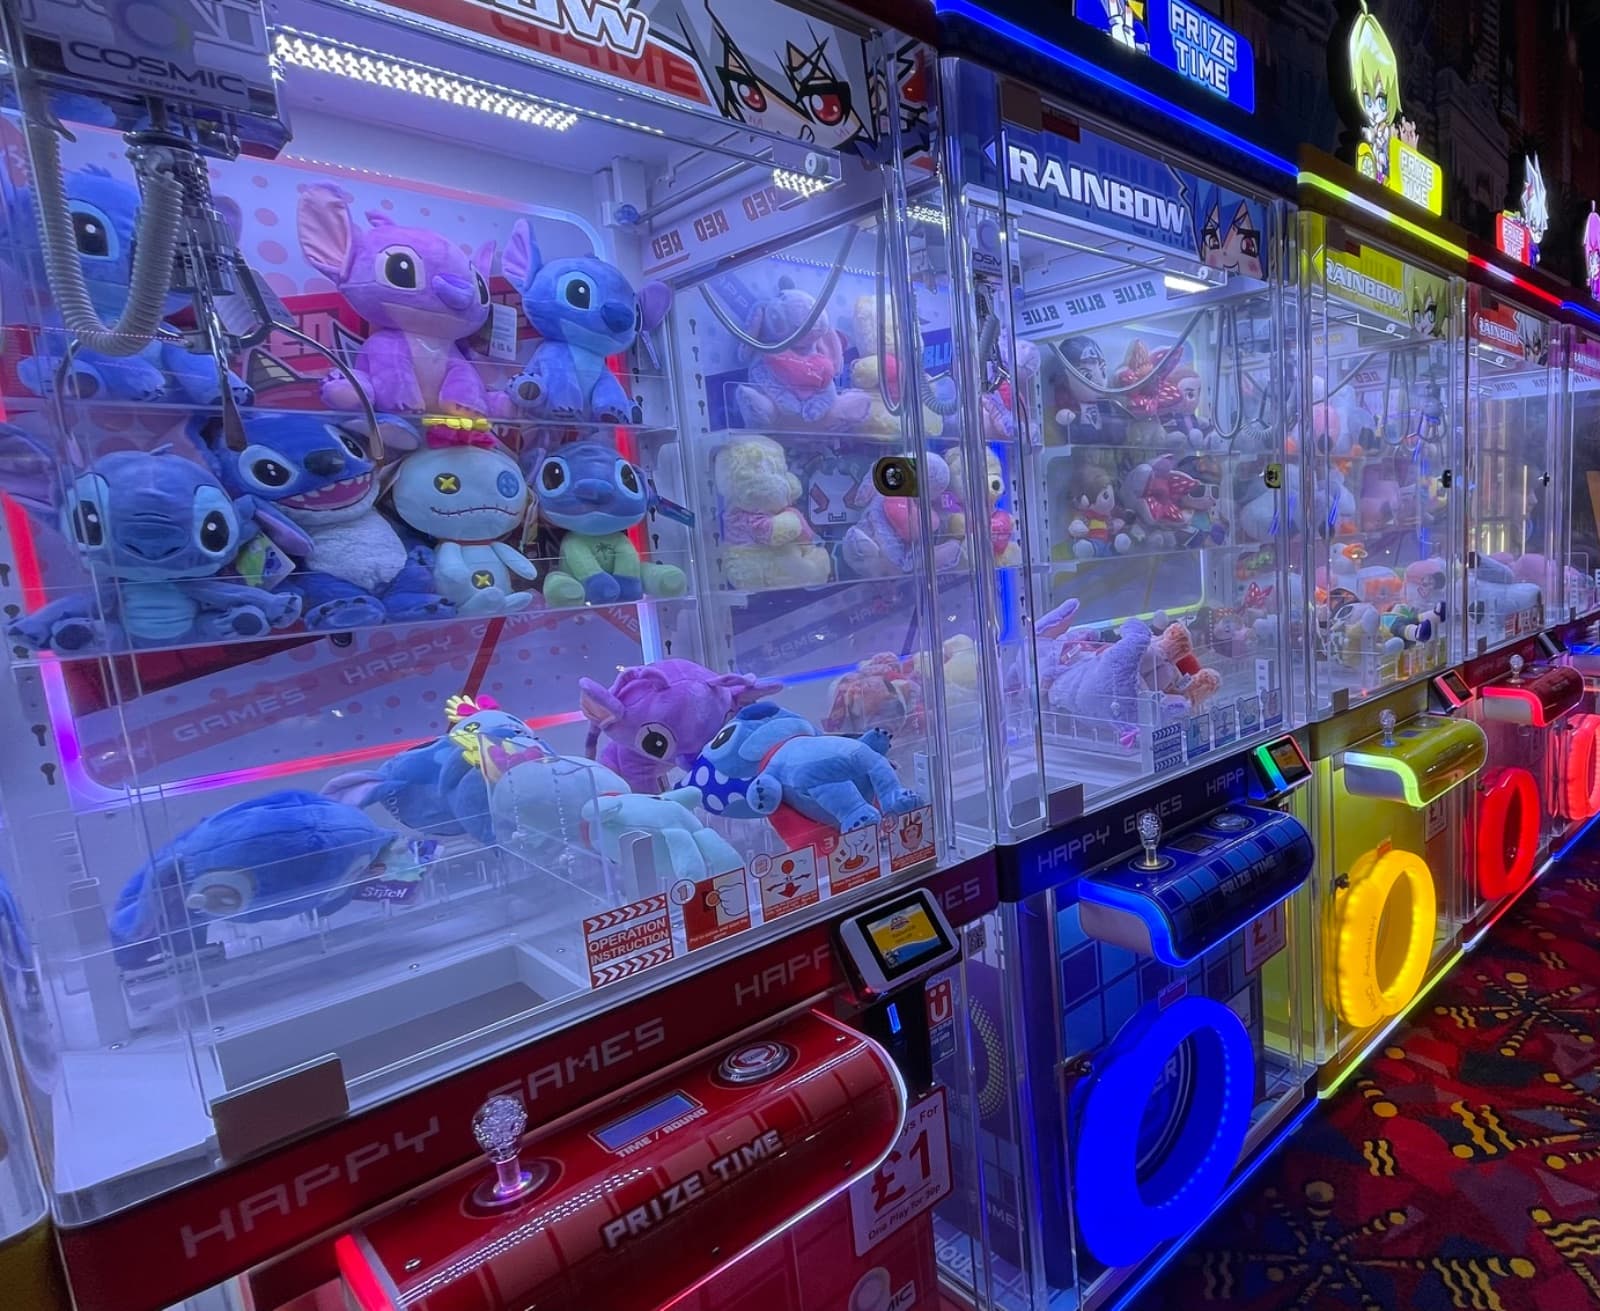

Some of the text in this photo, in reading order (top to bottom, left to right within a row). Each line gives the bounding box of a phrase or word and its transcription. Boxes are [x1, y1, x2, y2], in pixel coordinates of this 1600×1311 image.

[1170, 2, 1235, 67] PRIZE
[69, 41, 246, 95] COSMIC
[1174, 38, 1228, 93] TIME
[1007, 145, 1185, 234] RAINBOW
[1326, 257, 1402, 308] RAINBOW
[344, 637, 451, 684] HAPPY
[173, 688, 306, 743] GAMES
[1038, 768, 1245, 873] HAPPY GES HAPP
[589, 917, 667, 952] OPERATION
[590, 929, 669, 965] INSTRUCTION
[180, 1115, 441, 1259] HAPPY
[735, 944, 831, 1007] HAPP
[919, 1104, 938, 1124] For
[616, 1136, 652, 1158] TIME
[663, 1108, 709, 1134] ROUND
[603, 1129, 783, 1248] PRIZE TIME
[871, 1129, 931, 1213] £1
